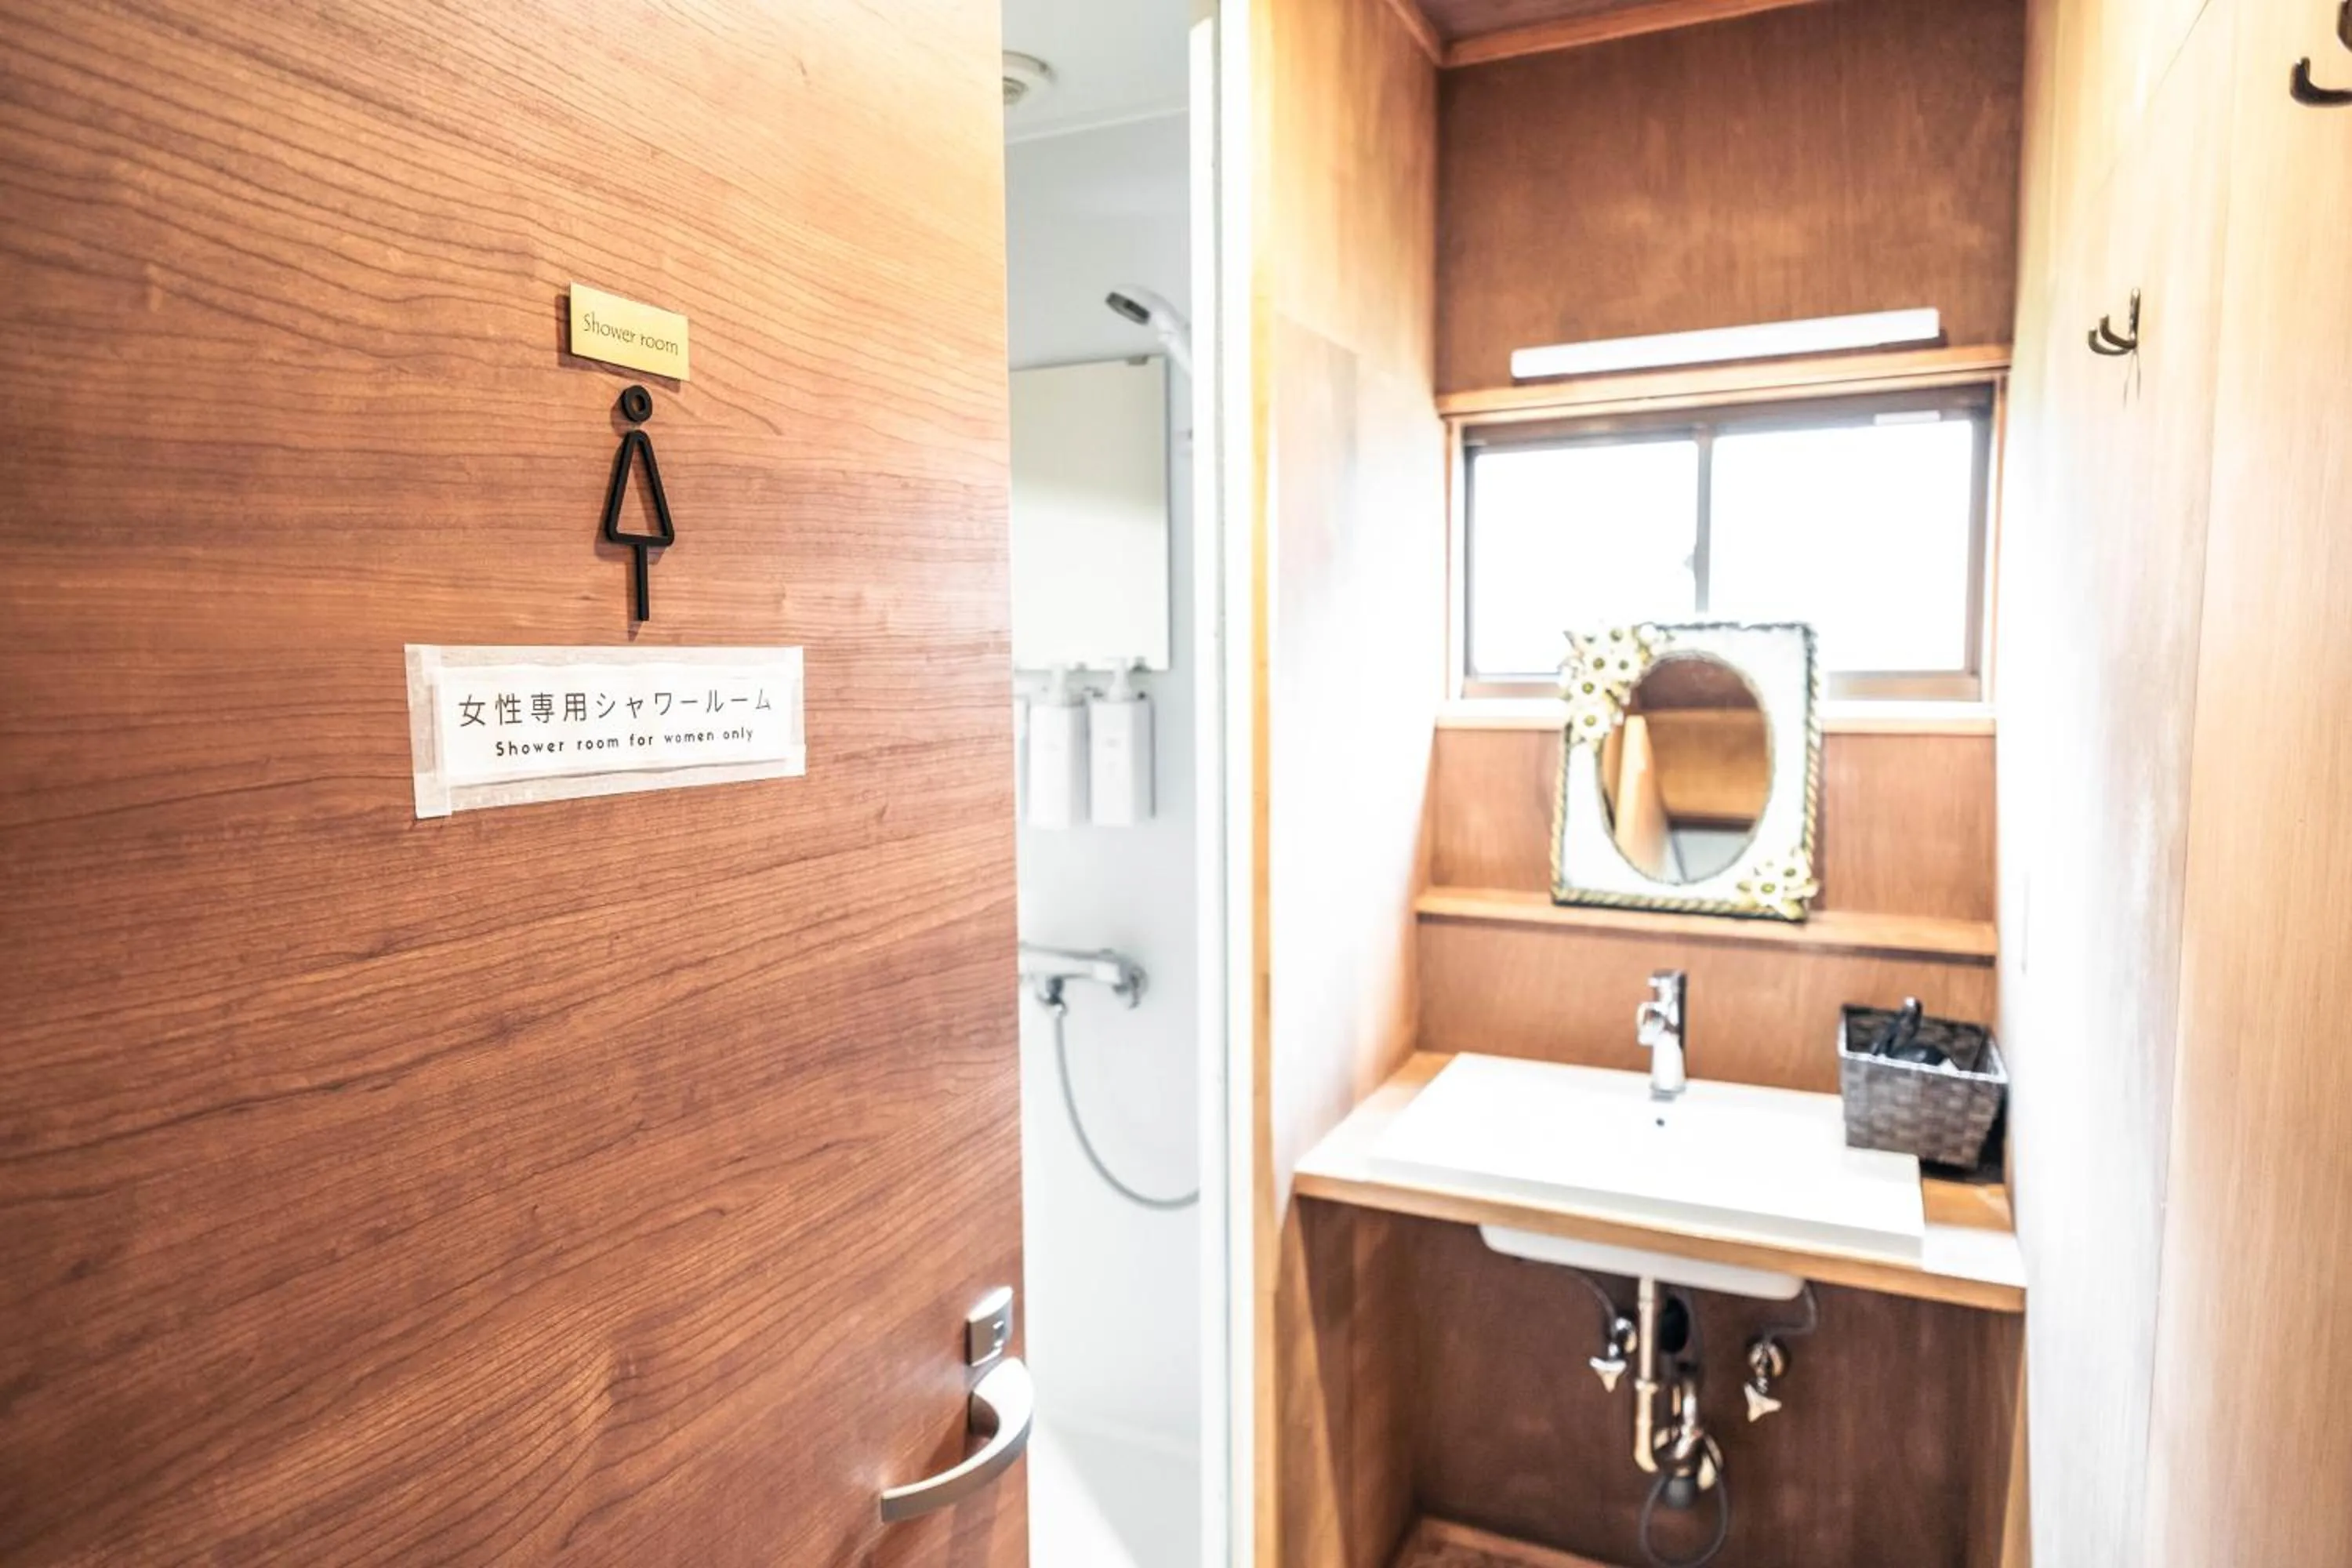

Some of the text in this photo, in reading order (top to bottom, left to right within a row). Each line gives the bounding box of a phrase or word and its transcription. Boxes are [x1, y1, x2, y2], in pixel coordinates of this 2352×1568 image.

[583, 311, 679, 356] Shower room
[459, 688, 772, 728] 女性専用シャワールーム
[495, 726, 754, 757] Shower room for women only
